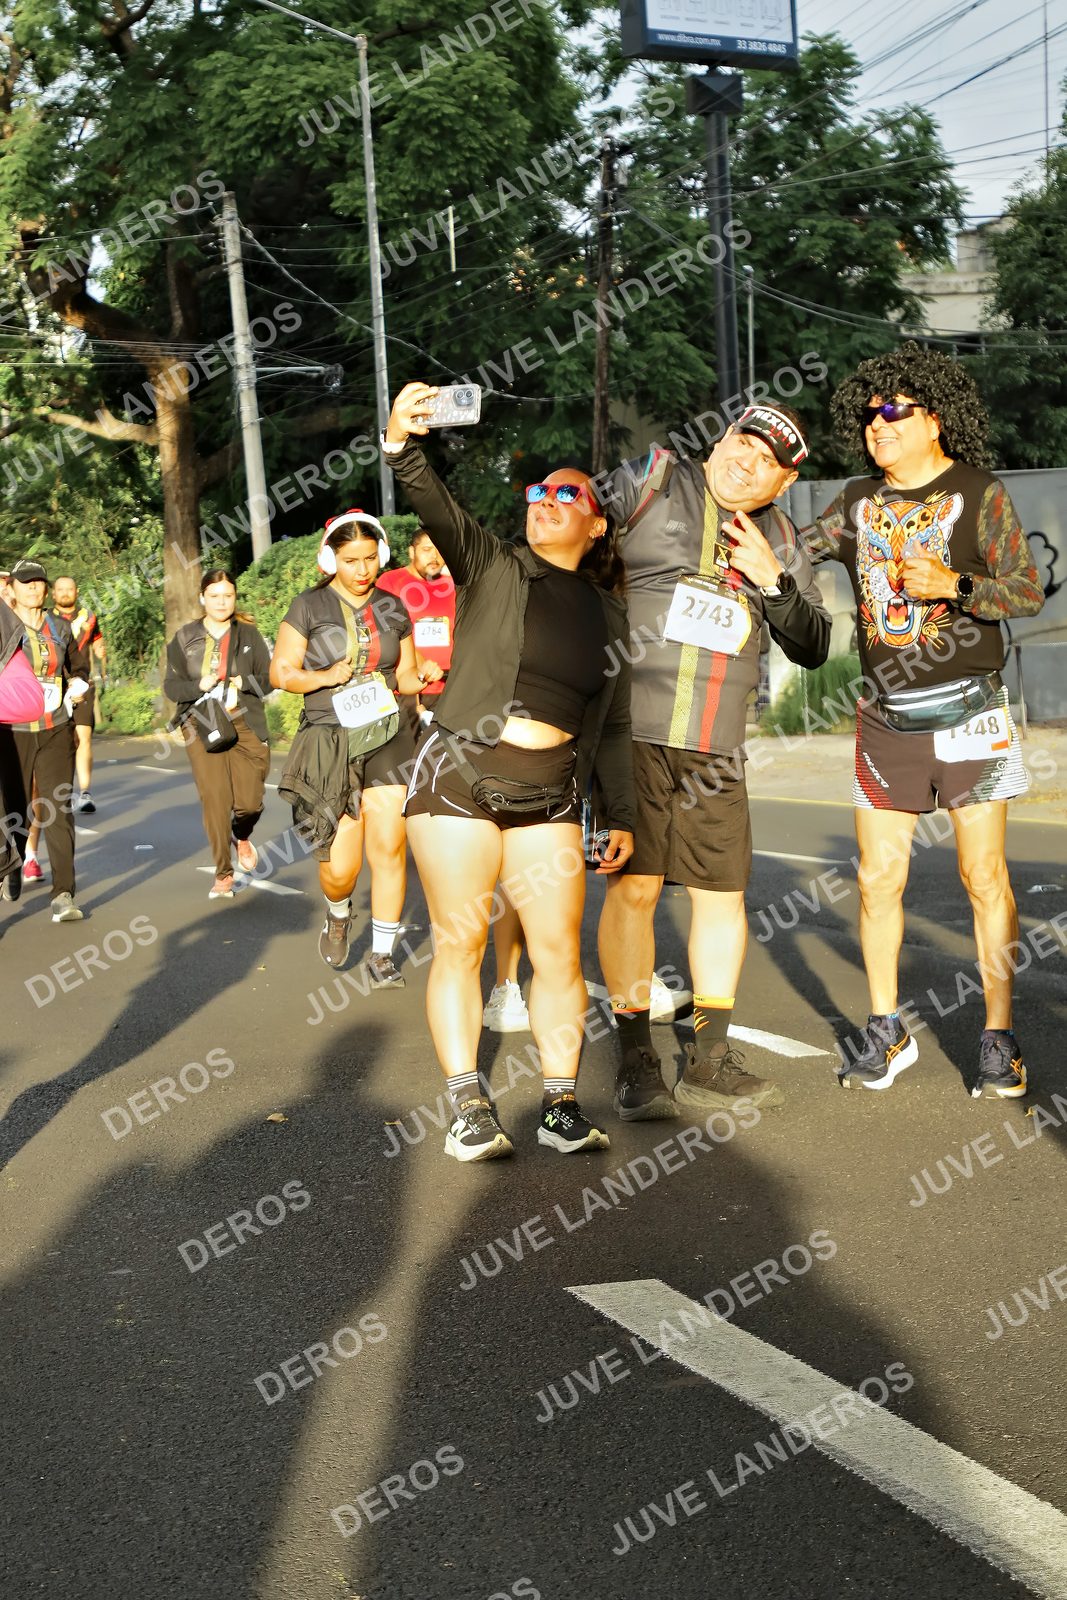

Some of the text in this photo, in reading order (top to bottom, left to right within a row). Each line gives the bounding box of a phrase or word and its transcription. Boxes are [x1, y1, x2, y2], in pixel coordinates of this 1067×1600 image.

[737, 40, 747, 50] 33
[681, 595, 734, 629] 2743
[343, 686, 377, 712] 6867
